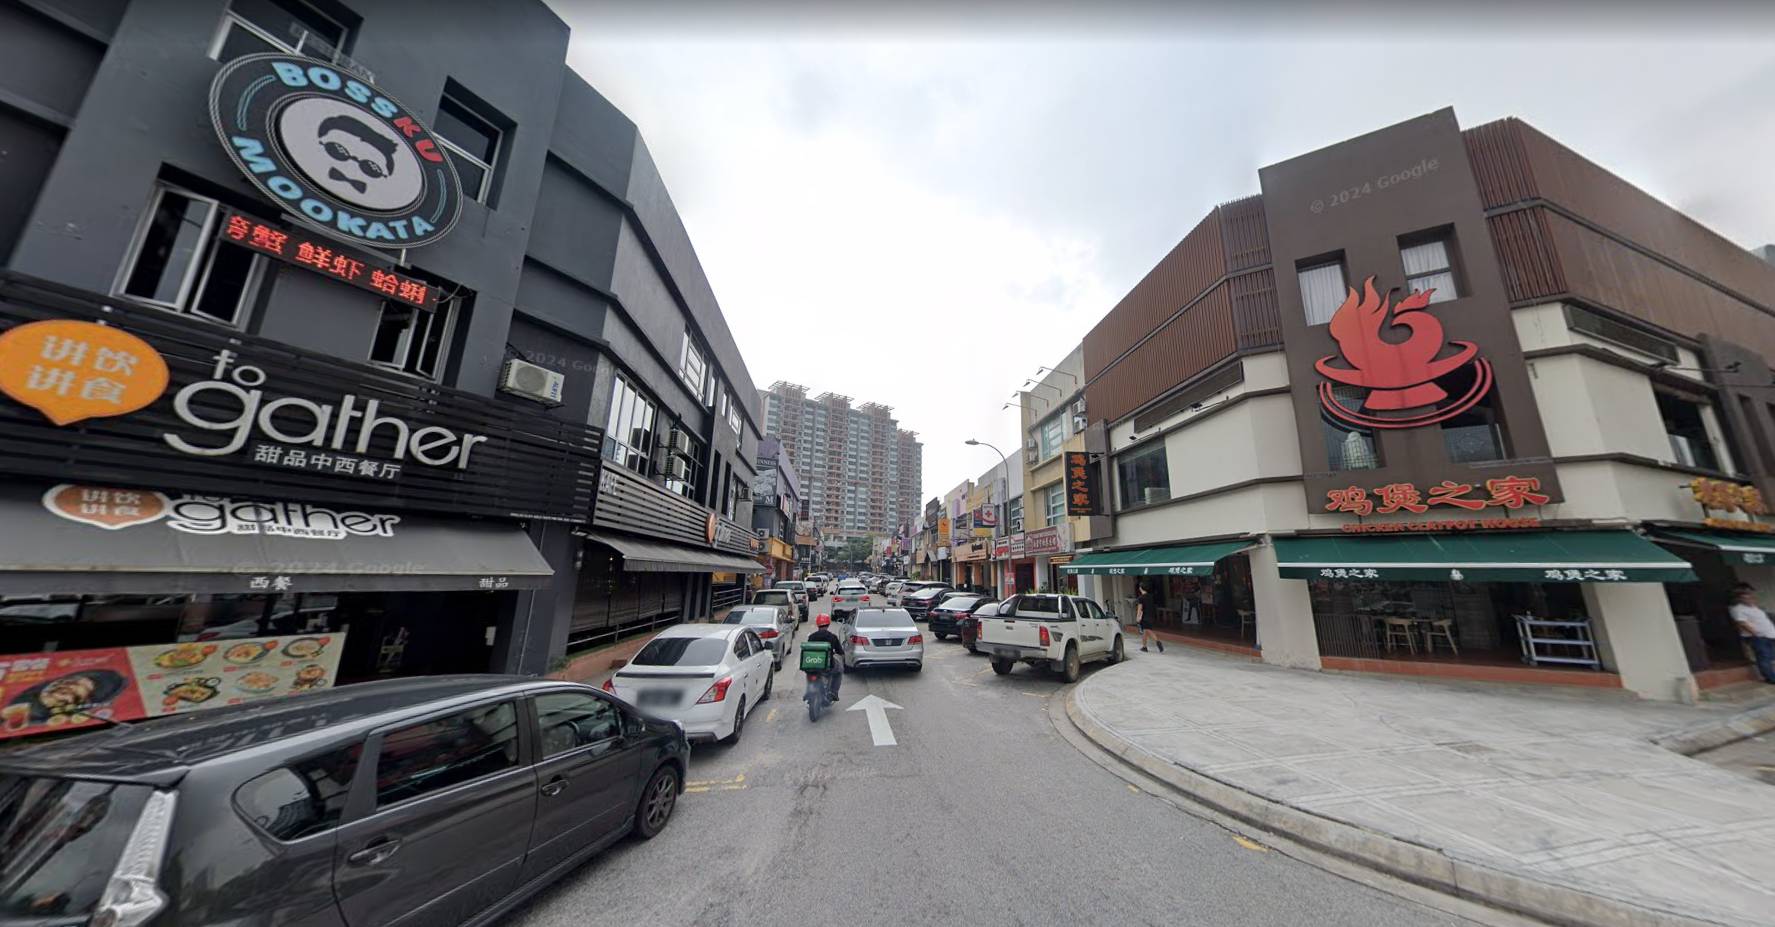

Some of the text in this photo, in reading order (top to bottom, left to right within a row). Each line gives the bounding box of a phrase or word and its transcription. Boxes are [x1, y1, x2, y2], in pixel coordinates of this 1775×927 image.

[231, 135, 436, 241] MOOKATA
[295, 241, 365, 280] 鲜虾
[370, 269, 427, 305] 蛤蜊
[40, 335, 139, 377] 讲饮
[26, 364, 127, 405] 讲食
[163, 380, 488, 470] gather
[254, 443, 401, 480] 甜品中西餐厅
[1325, 475, 1550, 517] 鸡煲之家
[171, 500, 397, 537] gather
[250, 576, 294, 590] 西餐
[479, 577, 509, 588] 甜品
[1320, 568, 1628, 581] 鸡煲之家 鸡煲之家
[805, 656, 822, 664] Grab
